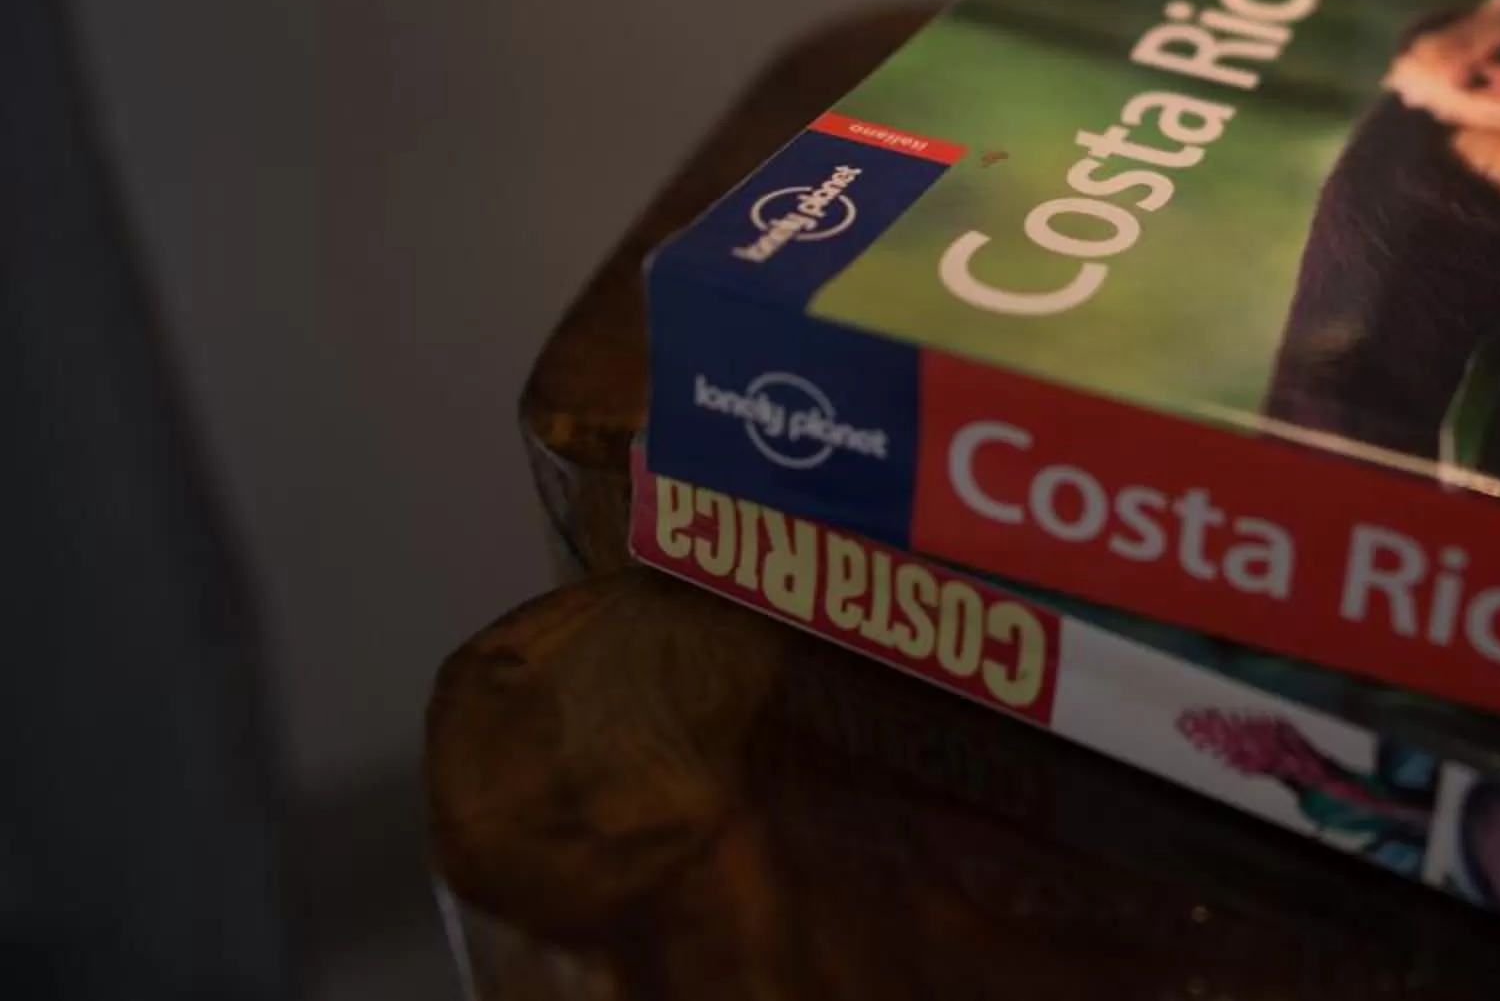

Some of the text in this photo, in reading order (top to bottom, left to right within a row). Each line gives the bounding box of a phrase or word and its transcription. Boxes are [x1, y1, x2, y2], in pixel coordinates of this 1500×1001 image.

[848, 122, 928, 152] italiano
[936, 90, 1237, 317] Costa
[693, 372, 890, 461] lonely planet
[947, 418, 1294, 600] Costa
